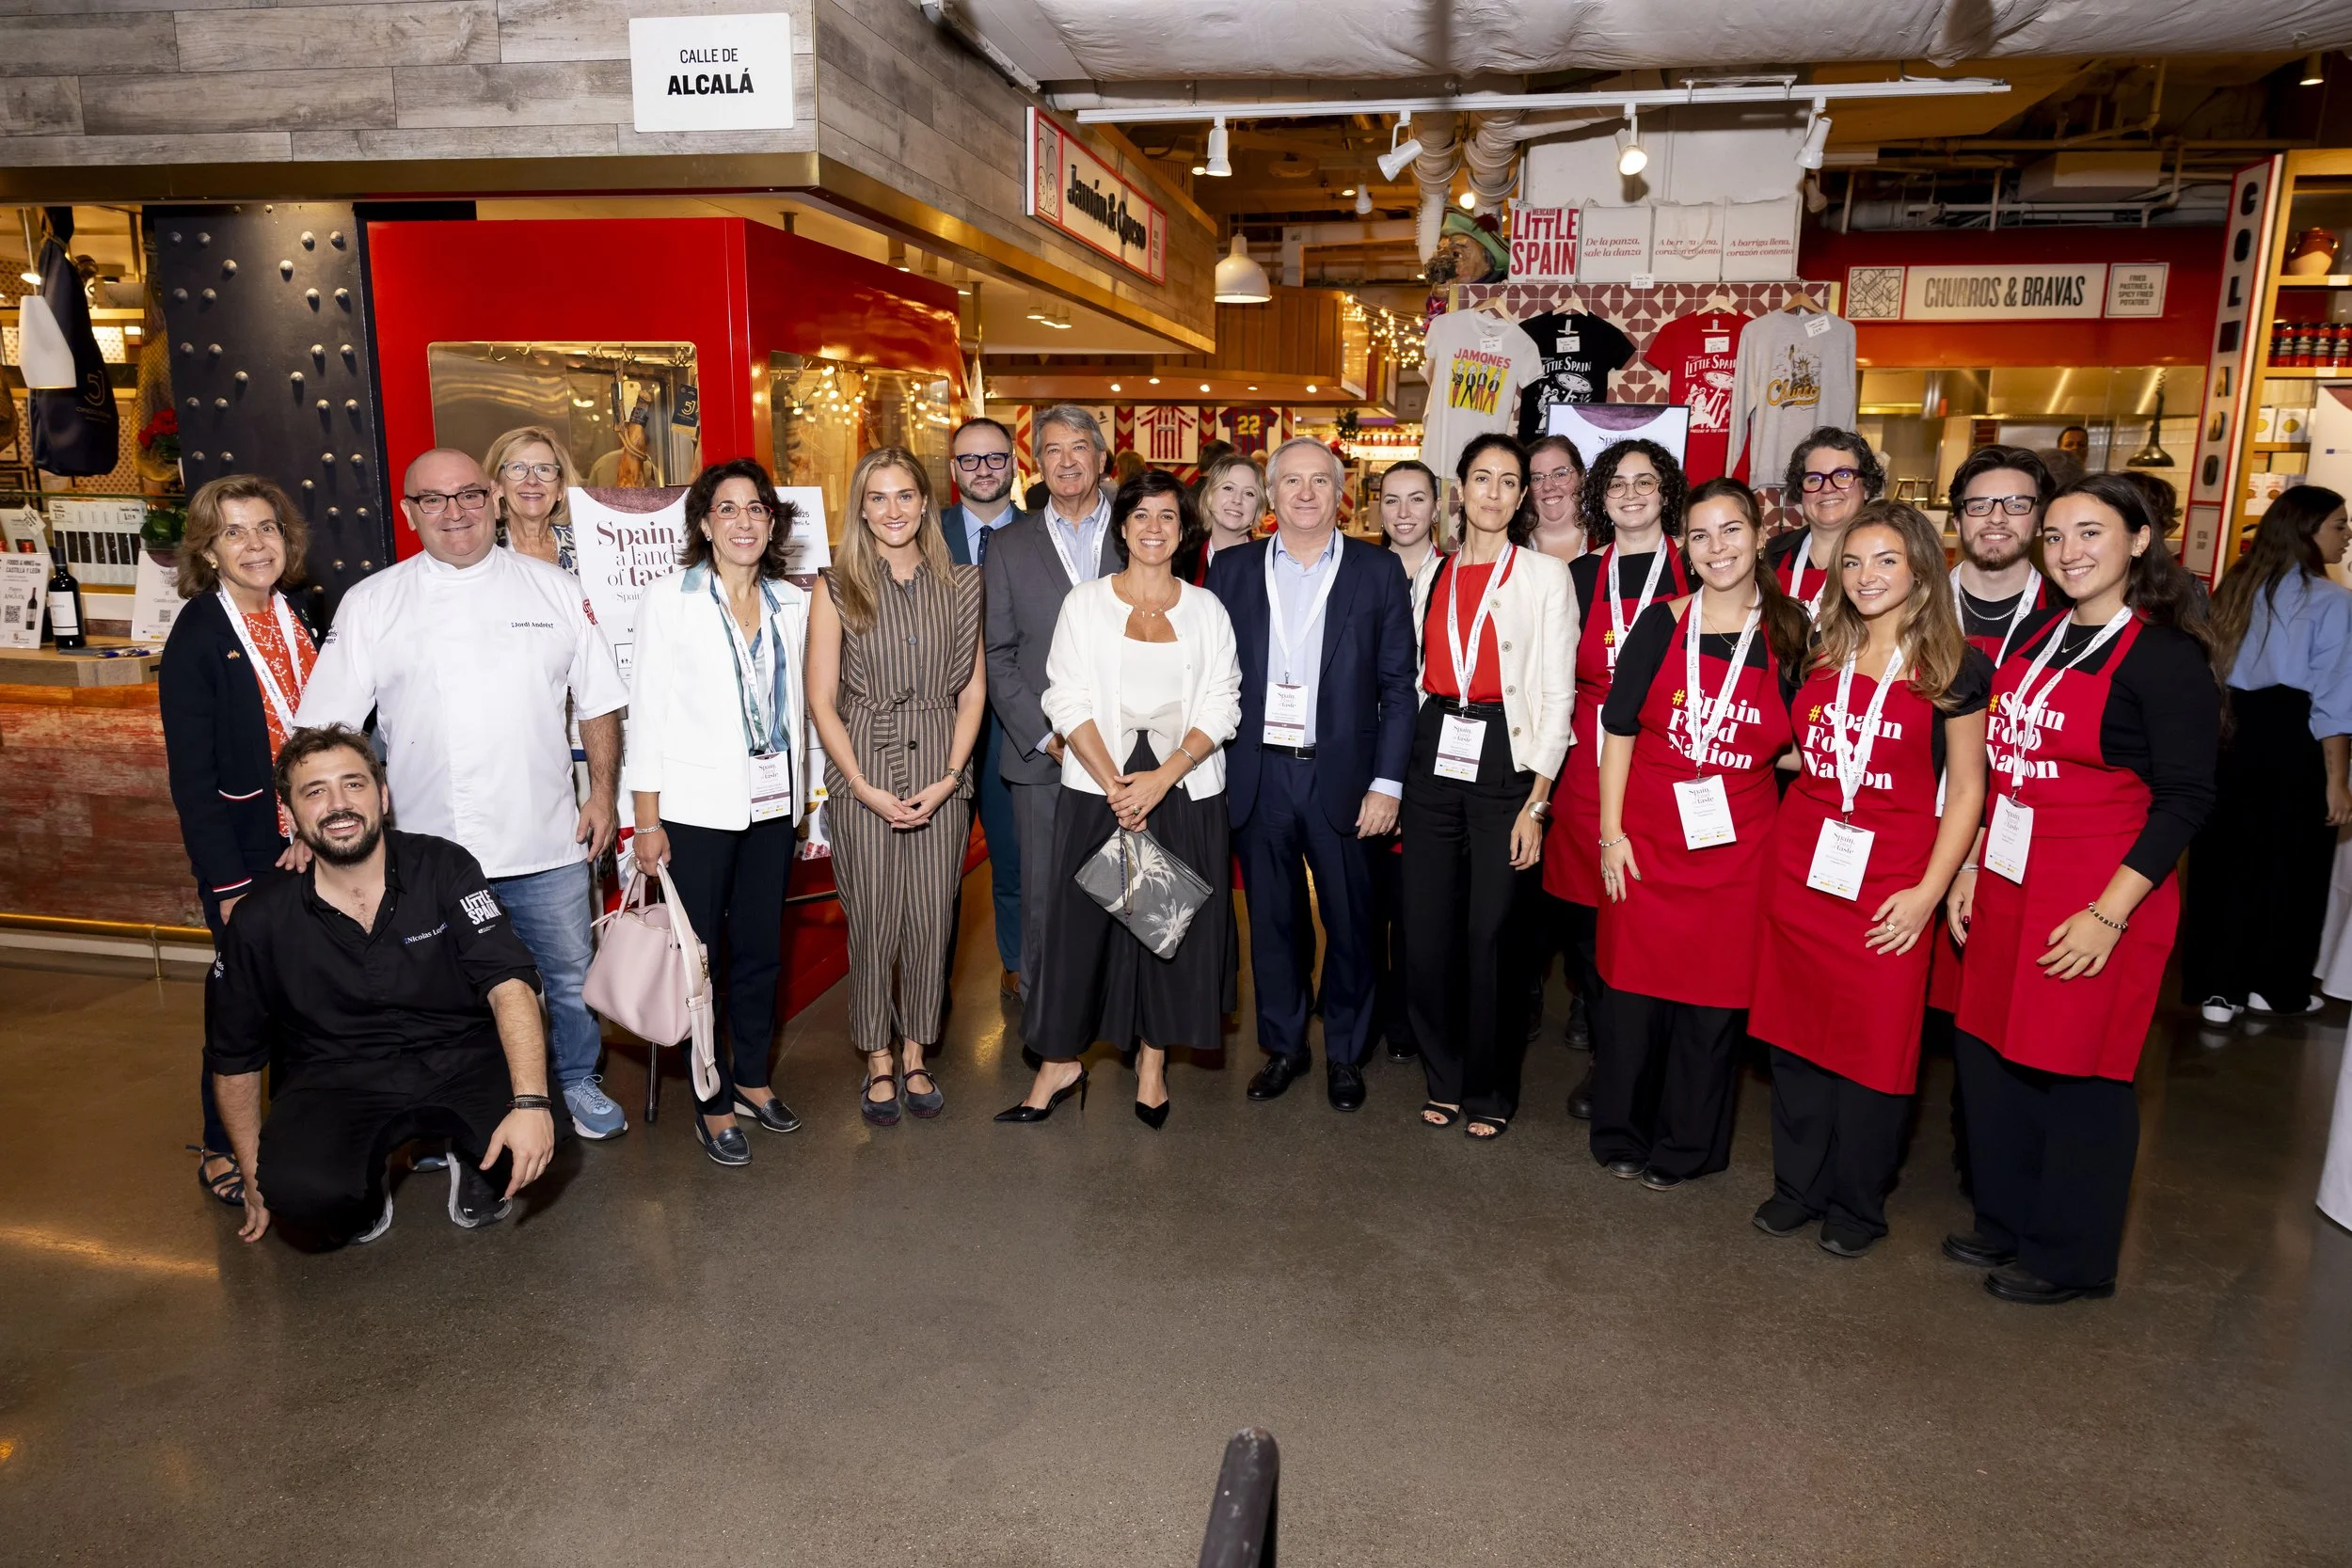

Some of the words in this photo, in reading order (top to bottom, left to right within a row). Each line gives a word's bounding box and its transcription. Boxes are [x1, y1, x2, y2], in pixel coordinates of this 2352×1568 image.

[680, 49, 719, 63] CALLE
[723, 48, 739, 62] DE
[667, 68, 755, 95] ALCALÁ
[1512, 209, 1580, 240] LITTLE
[1583, 248, 1600, 257] sale
[1603, 247, 1612, 256] la
[1613, 247, 1642, 256] danza
[1585, 238, 1598, 246] De
[1599, 237, 1609, 245] la
[1726, 248, 1758, 257] corazón
[1511, 242, 1577, 276] SPAIN
[1924, 277, 2001, 308] CHURROS
[2003, 277, 2017, 307] &
[2022, 276, 2085, 306] BRAVAS
[1454, 348, 1512, 370] JAMONES
[1564, 356, 1592, 372] SPAIN
[1685, 358, 1711, 378] LITTLE
[1768, 378, 1820, 406] Churro
[1237, 415, 1261, 436] 22
[596, 521, 683, 553] Spain.
[616, 554, 626, 566] a
[631, 544, 676, 565] land
[607, 568, 625, 586] of
[1667, 708, 1738, 743] Fd
[459, 890, 494, 912] LITTLE
[468, 902, 501, 926] SPAIN
[406, 932, 433, 943] Nicolas
